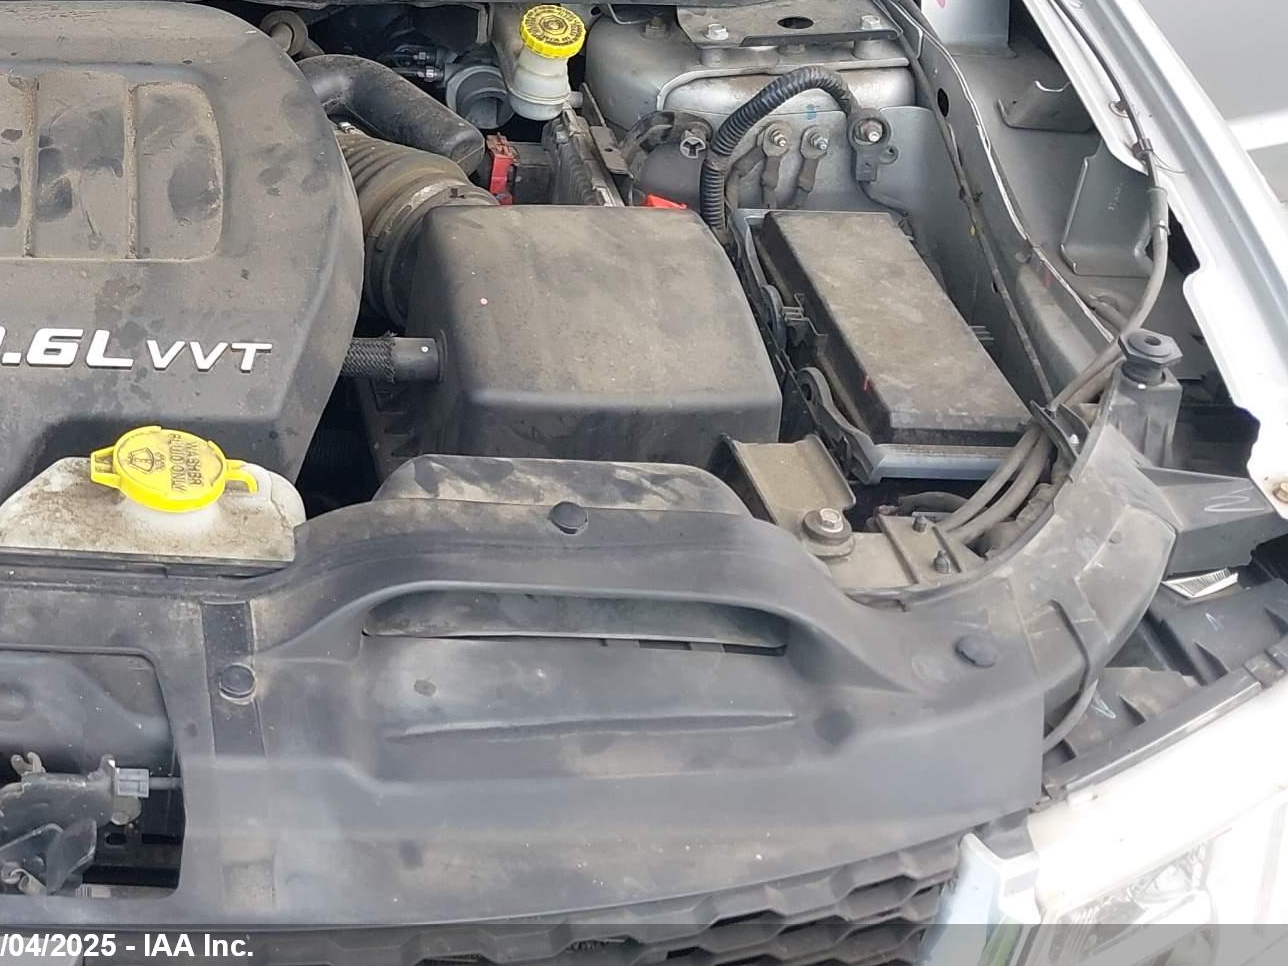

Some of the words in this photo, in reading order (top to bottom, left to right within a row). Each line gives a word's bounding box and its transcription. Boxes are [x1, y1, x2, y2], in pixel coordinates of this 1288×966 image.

[146, 339, 273, 373] VVT
[168, 433, 185, 464] FLUID
[170, 464, 187, 492] ONLY
